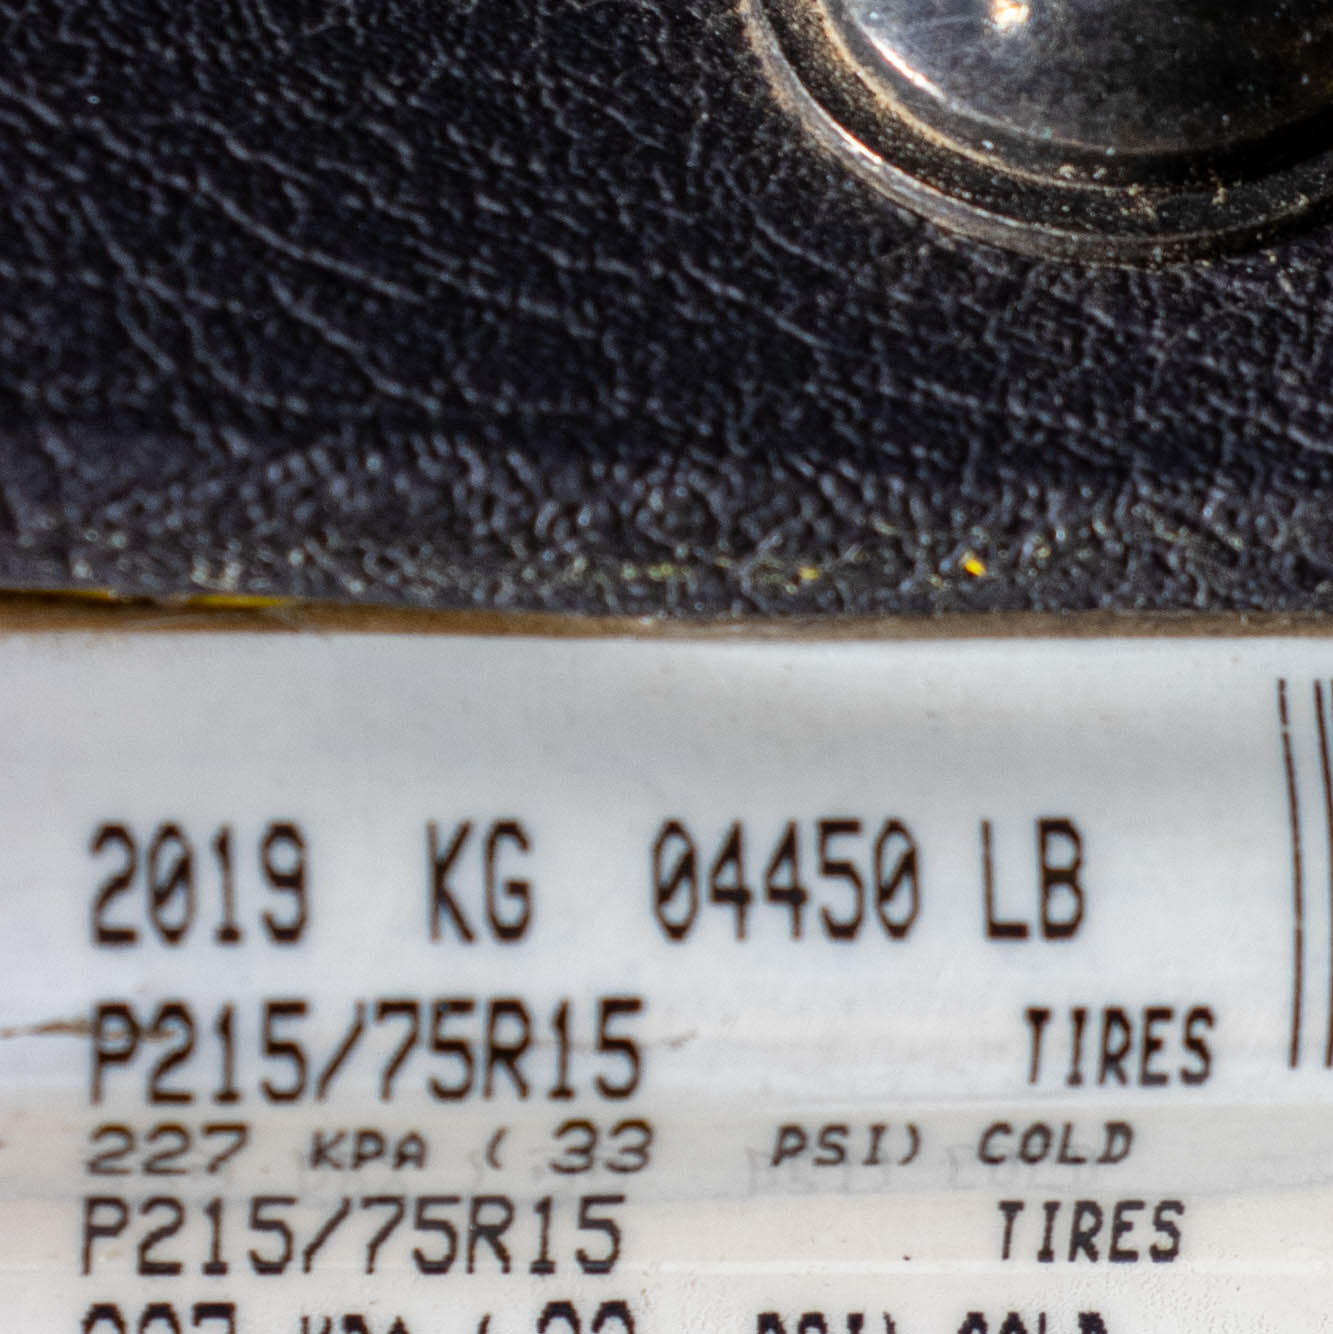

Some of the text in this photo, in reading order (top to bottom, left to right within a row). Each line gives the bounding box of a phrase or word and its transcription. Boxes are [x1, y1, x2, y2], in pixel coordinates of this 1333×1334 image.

[90, 816, 1085, 948] 2019 KG 04450 LB
[90, 997, 1215, 1103] P215/75R15 TIRES
[86, 1122, 250, 1177] 227
[308, 1128, 427, 1171] KPA
[550, 1118, 654, 1176] 33
[770, 1123, 921, 1168] PSI)
[977, 1121, 1134, 1166] COLD
[81, 1193, 1185, 1277] P215/75R15 TIRES
